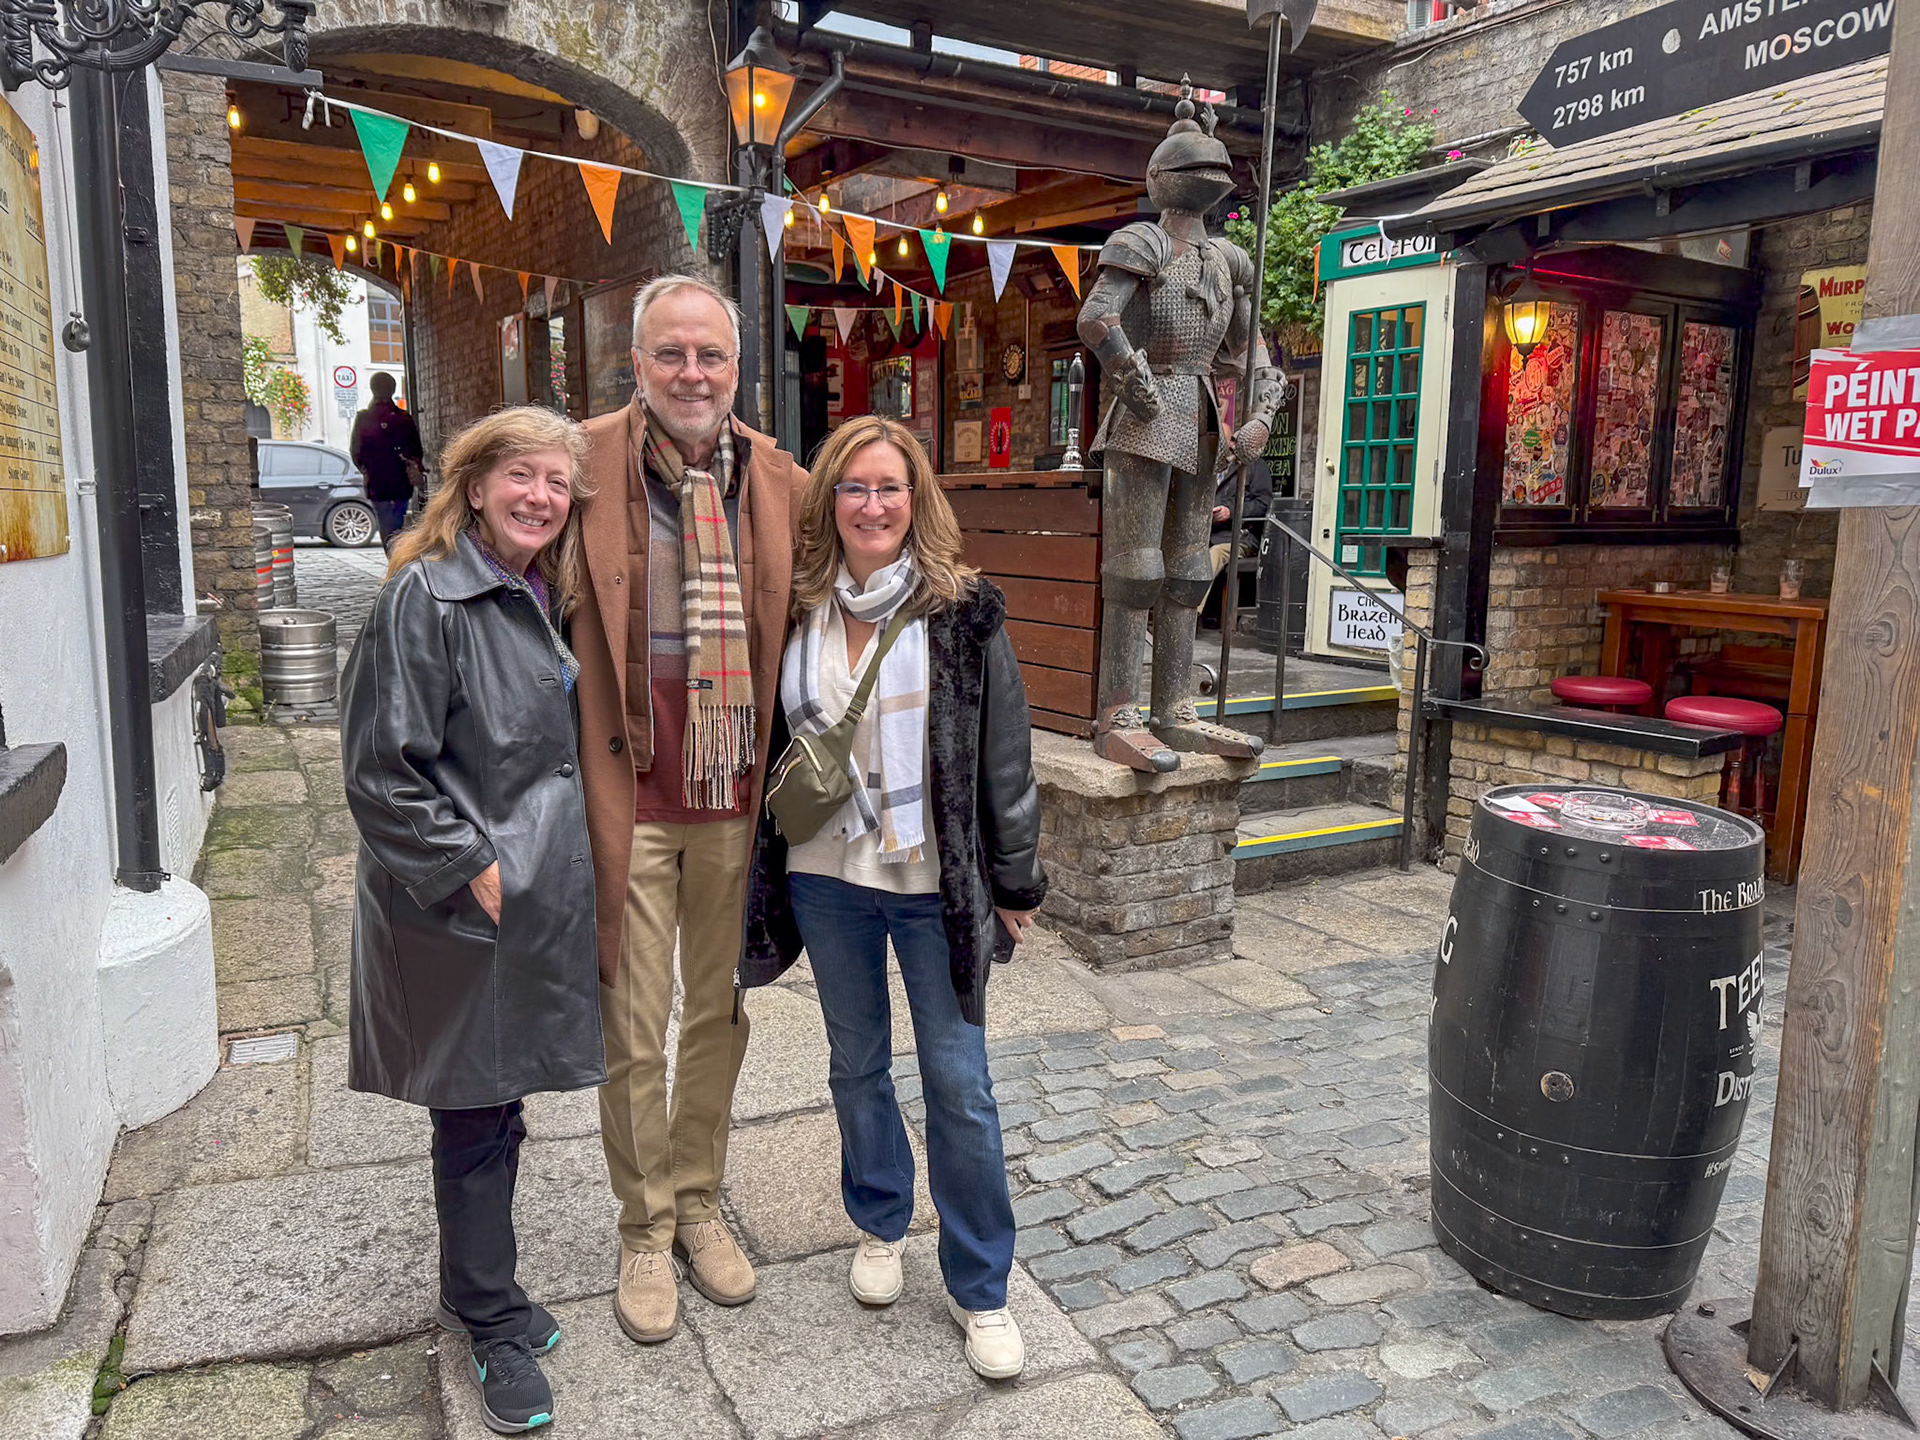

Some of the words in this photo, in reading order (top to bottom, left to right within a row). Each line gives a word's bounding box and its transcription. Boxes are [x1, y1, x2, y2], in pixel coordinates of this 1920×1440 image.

[1744, 0, 1895, 70] MOSCOW
[1555, 57, 1593, 88] 757
[1599, 47, 1634, 75] km
[1552, 94, 1604, 130] 2798
[1610, 85, 1645, 112] km
[1824, 362, 1920, 409] PÉINT
[1825, 410, 1888, 442] WET
[1810, 466, 1838, 475] Dulux
